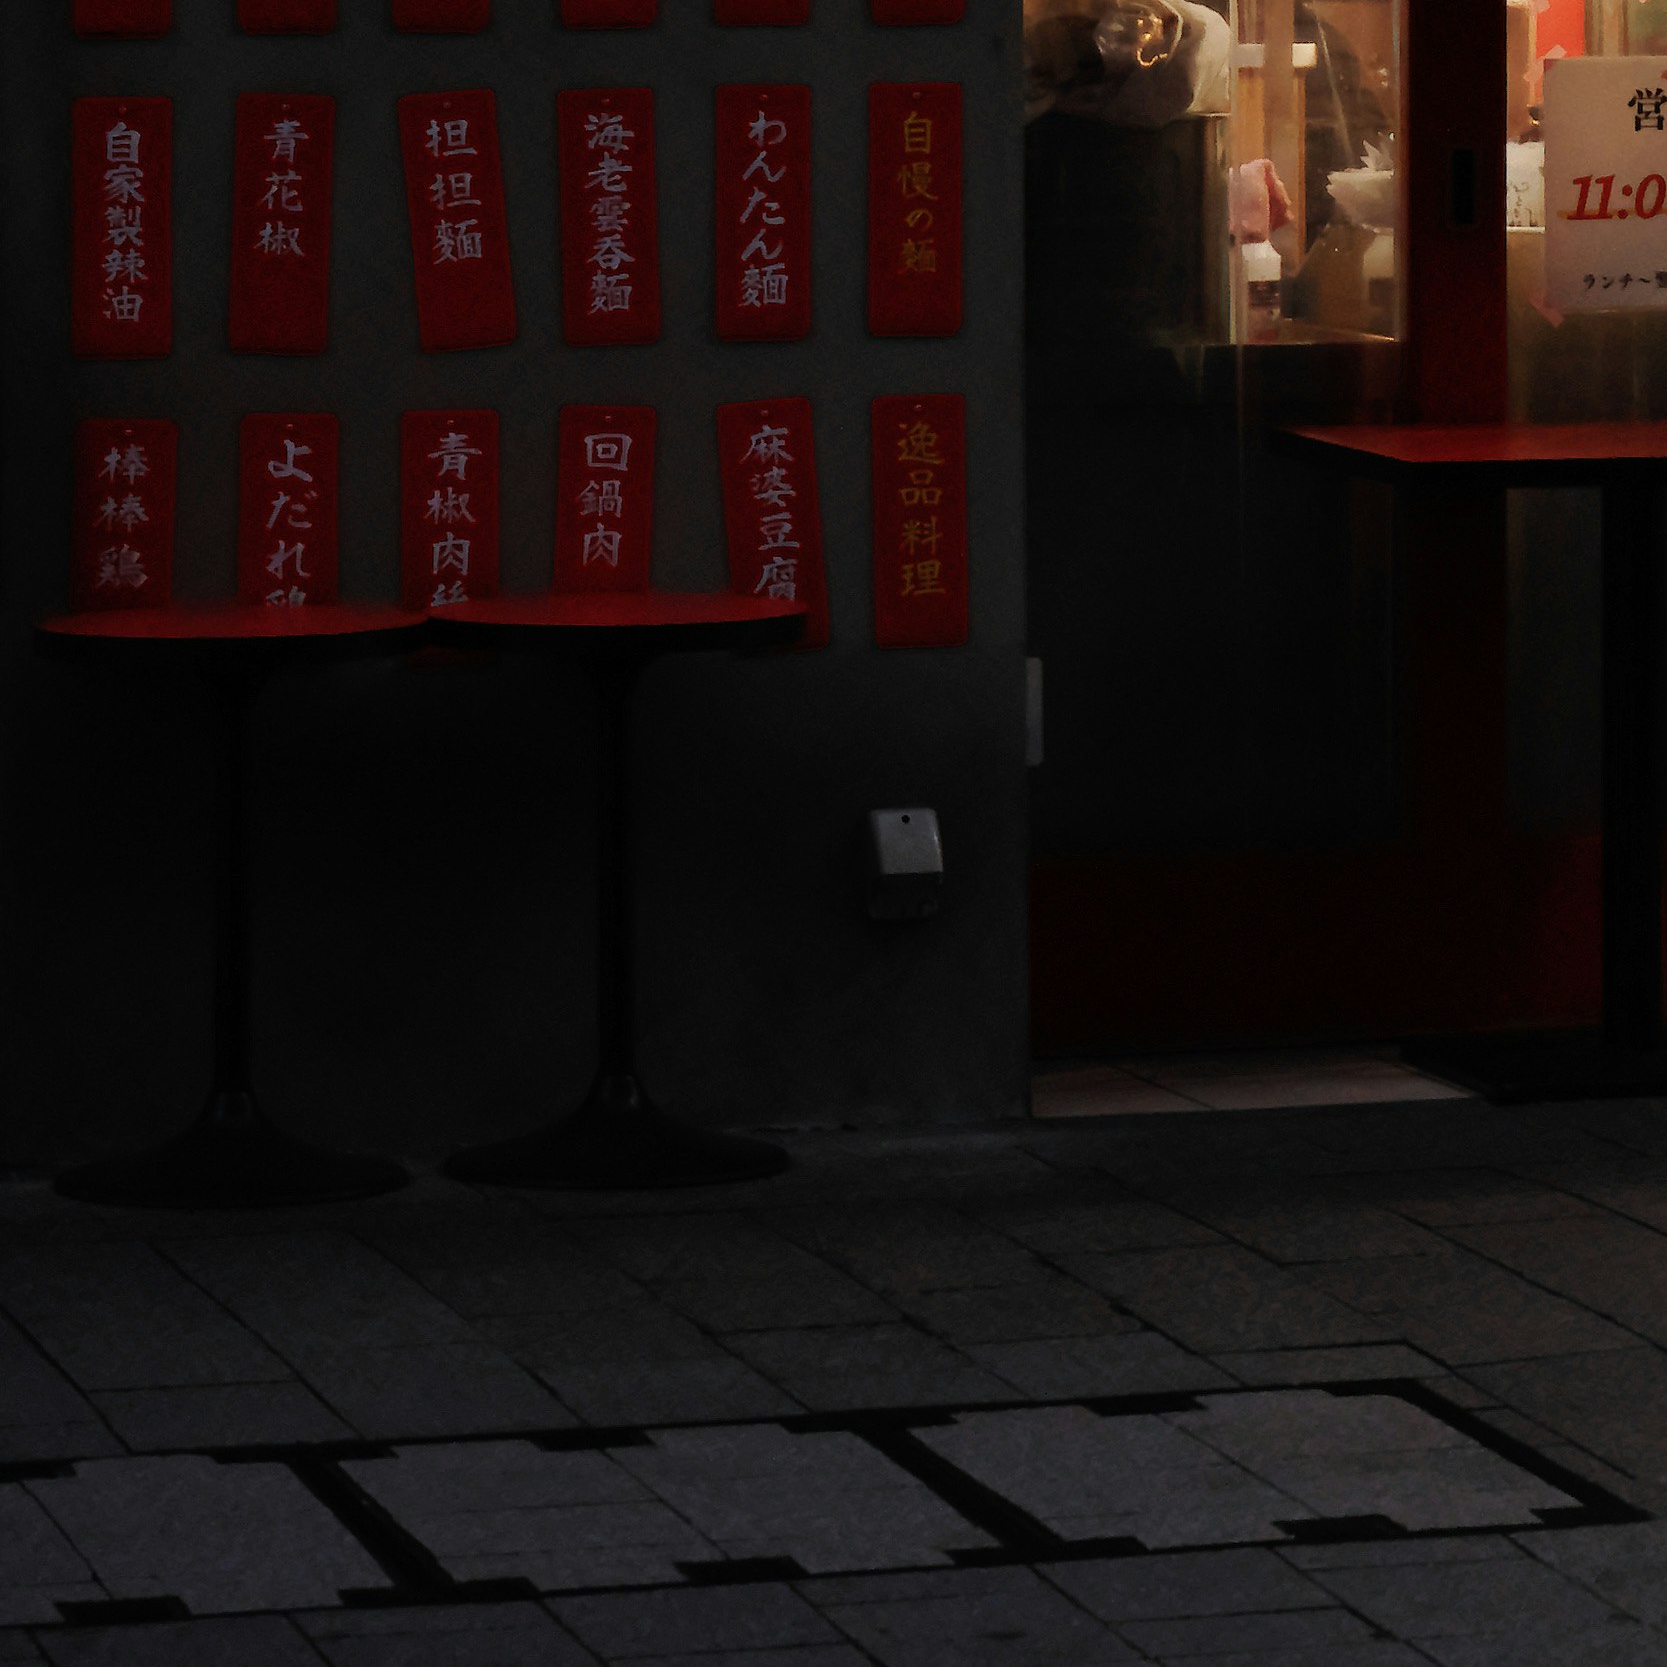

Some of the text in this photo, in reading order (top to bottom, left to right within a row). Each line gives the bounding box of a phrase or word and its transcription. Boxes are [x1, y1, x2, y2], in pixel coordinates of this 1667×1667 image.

[102, 121, 147, 322] 自家製辣油
[258, 119, 309, 255] 青花椒
[100, 444, 149, 587] 棒棒鶏
[580, 433, 633, 566] 回鍋肉
[897, 421, 945, 596] 逸品料理
